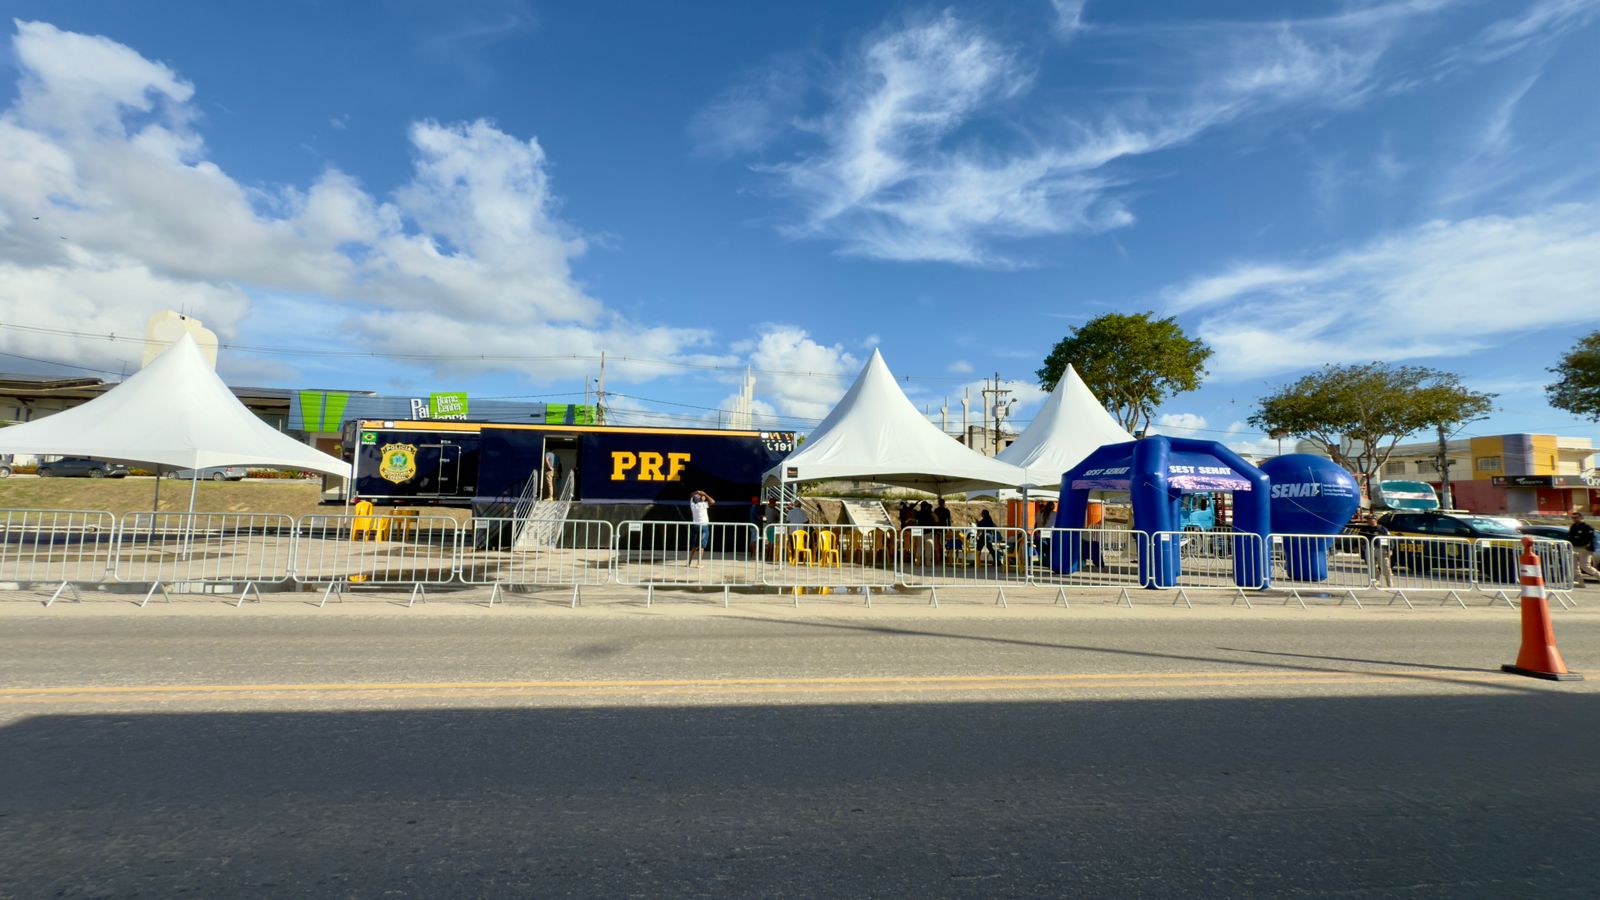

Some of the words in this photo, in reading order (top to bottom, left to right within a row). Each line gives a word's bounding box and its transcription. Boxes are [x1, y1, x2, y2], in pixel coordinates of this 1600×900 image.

[774, 442, 792, 452] 191
[611, 451, 691, 481] PRF
[1169, 465, 1195, 474] SEST
[1198, 466, 1231, 475] SENAT
[1271, 482, 1320, 498] SENAT
